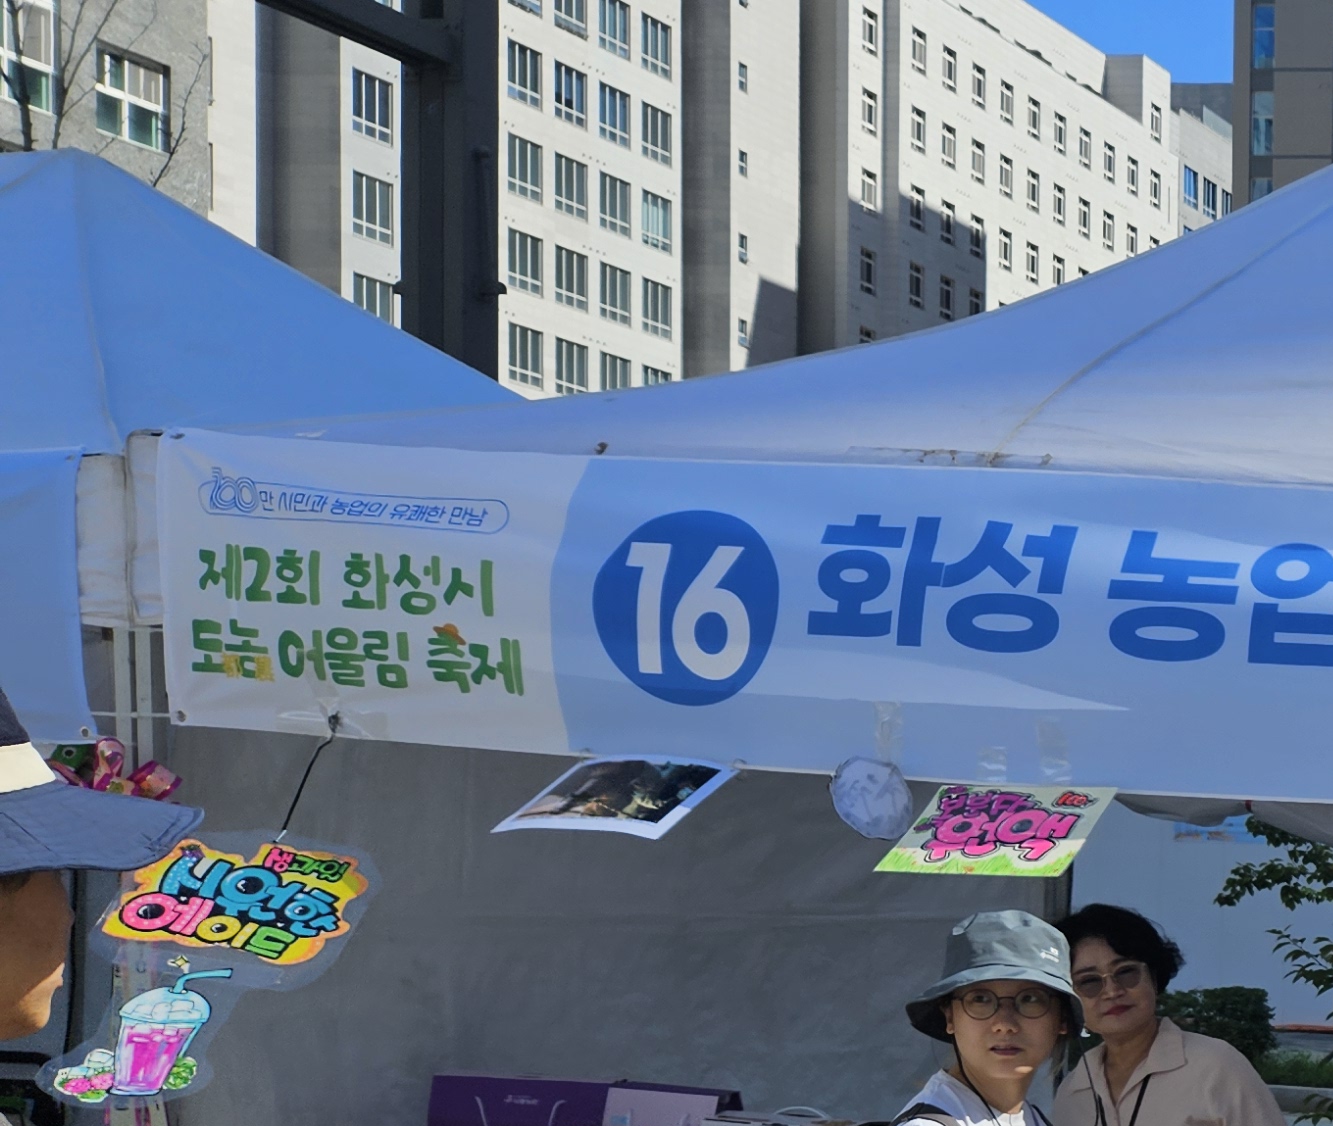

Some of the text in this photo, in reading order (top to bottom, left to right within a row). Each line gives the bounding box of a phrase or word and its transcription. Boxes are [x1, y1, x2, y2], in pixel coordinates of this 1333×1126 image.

[278, 491, 327, 513] 시민과
[330, 498, 385, 518] 농업의
[389, 503, 446, 524] 유쾌한
[448, 507, 489, 528] 만남
[199, 543, 494, 617] 제2회 화성시
[625, 542, 751, 682] 16
[807, 514, 1079, 654] 화성
[427, 628, 524, 696] 축제
[264, 847, 350, 884] 생과일
[921, 809, 1081, 862] 원액
[119, 891, 296, 959] 에이드
[160, 854, 342, 937] 시원한
